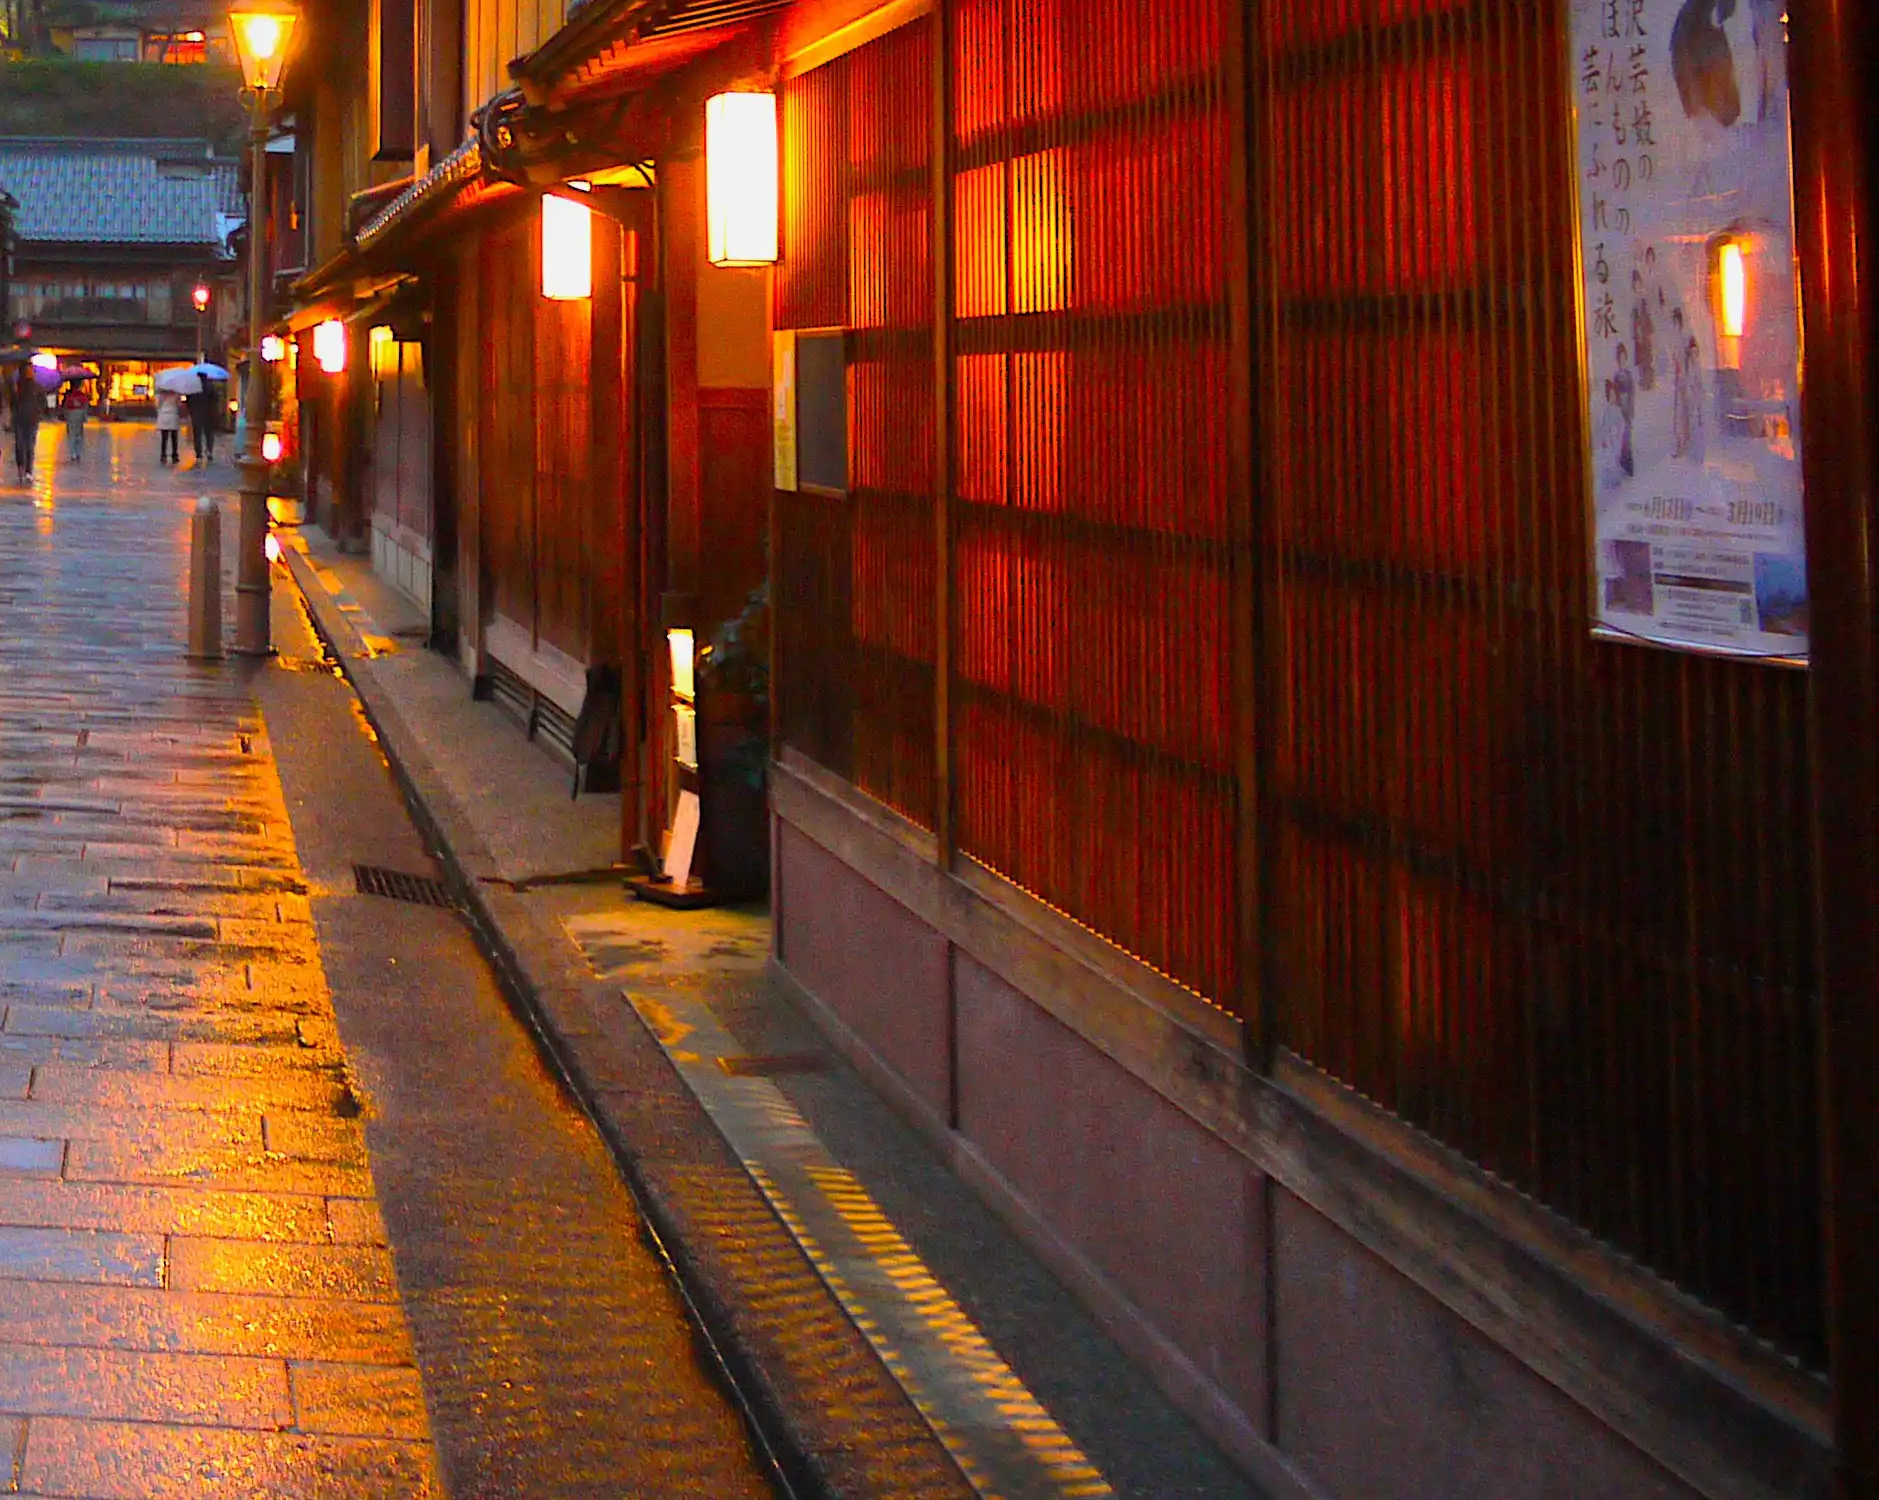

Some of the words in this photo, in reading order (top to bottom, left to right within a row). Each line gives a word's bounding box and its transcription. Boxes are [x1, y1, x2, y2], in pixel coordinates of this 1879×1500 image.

[1582, 45, 1618, 339] 芸にふれる旅
[1601, 0, 1631, 236] ほんものの
